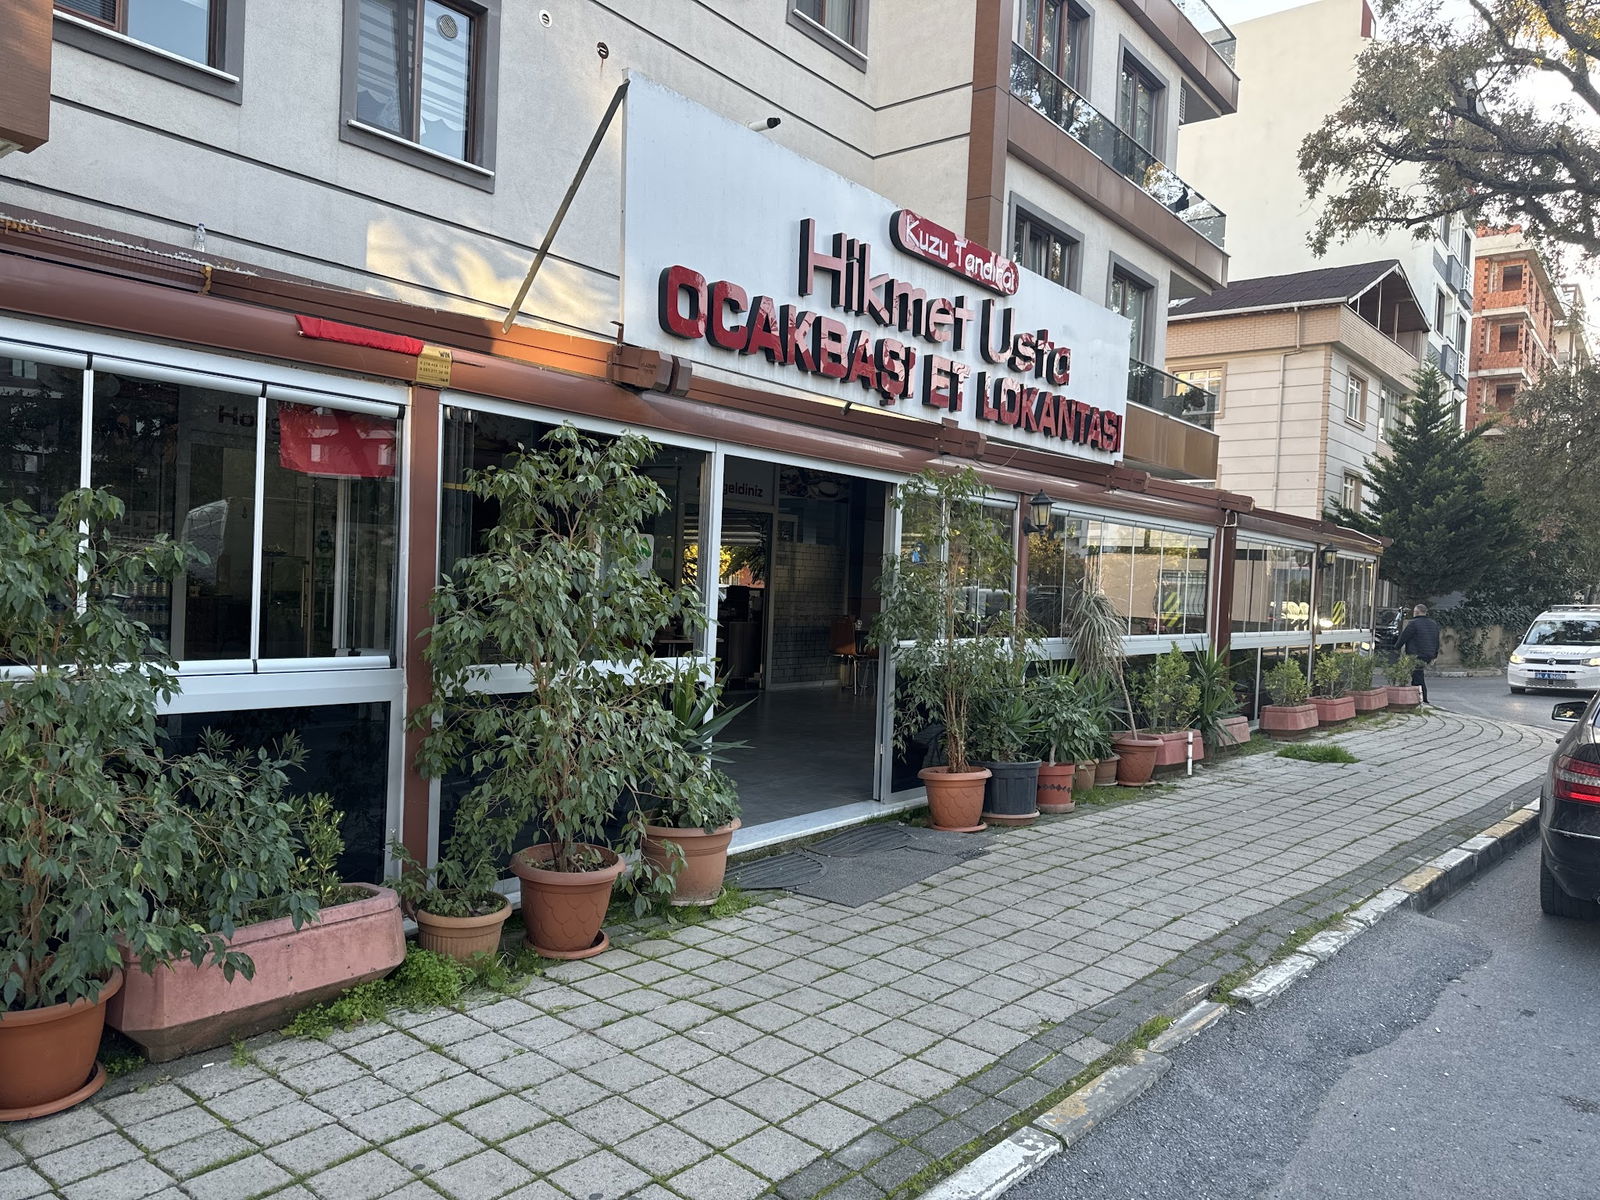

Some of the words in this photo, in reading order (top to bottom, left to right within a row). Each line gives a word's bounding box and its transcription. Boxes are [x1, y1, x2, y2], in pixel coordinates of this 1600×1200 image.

[906, 214, 949, 261] Kuzu
[799, 218, 976, 351] Hikmet
[980, 299, 1072, 386] Usta
[658, 265, 916, 406] OCAKBAŞI
[922, 354, 970, 413] ET
[976, 371, 1123, 453] LOKANTASI
[723, 482, 764, 497] geldiniz
